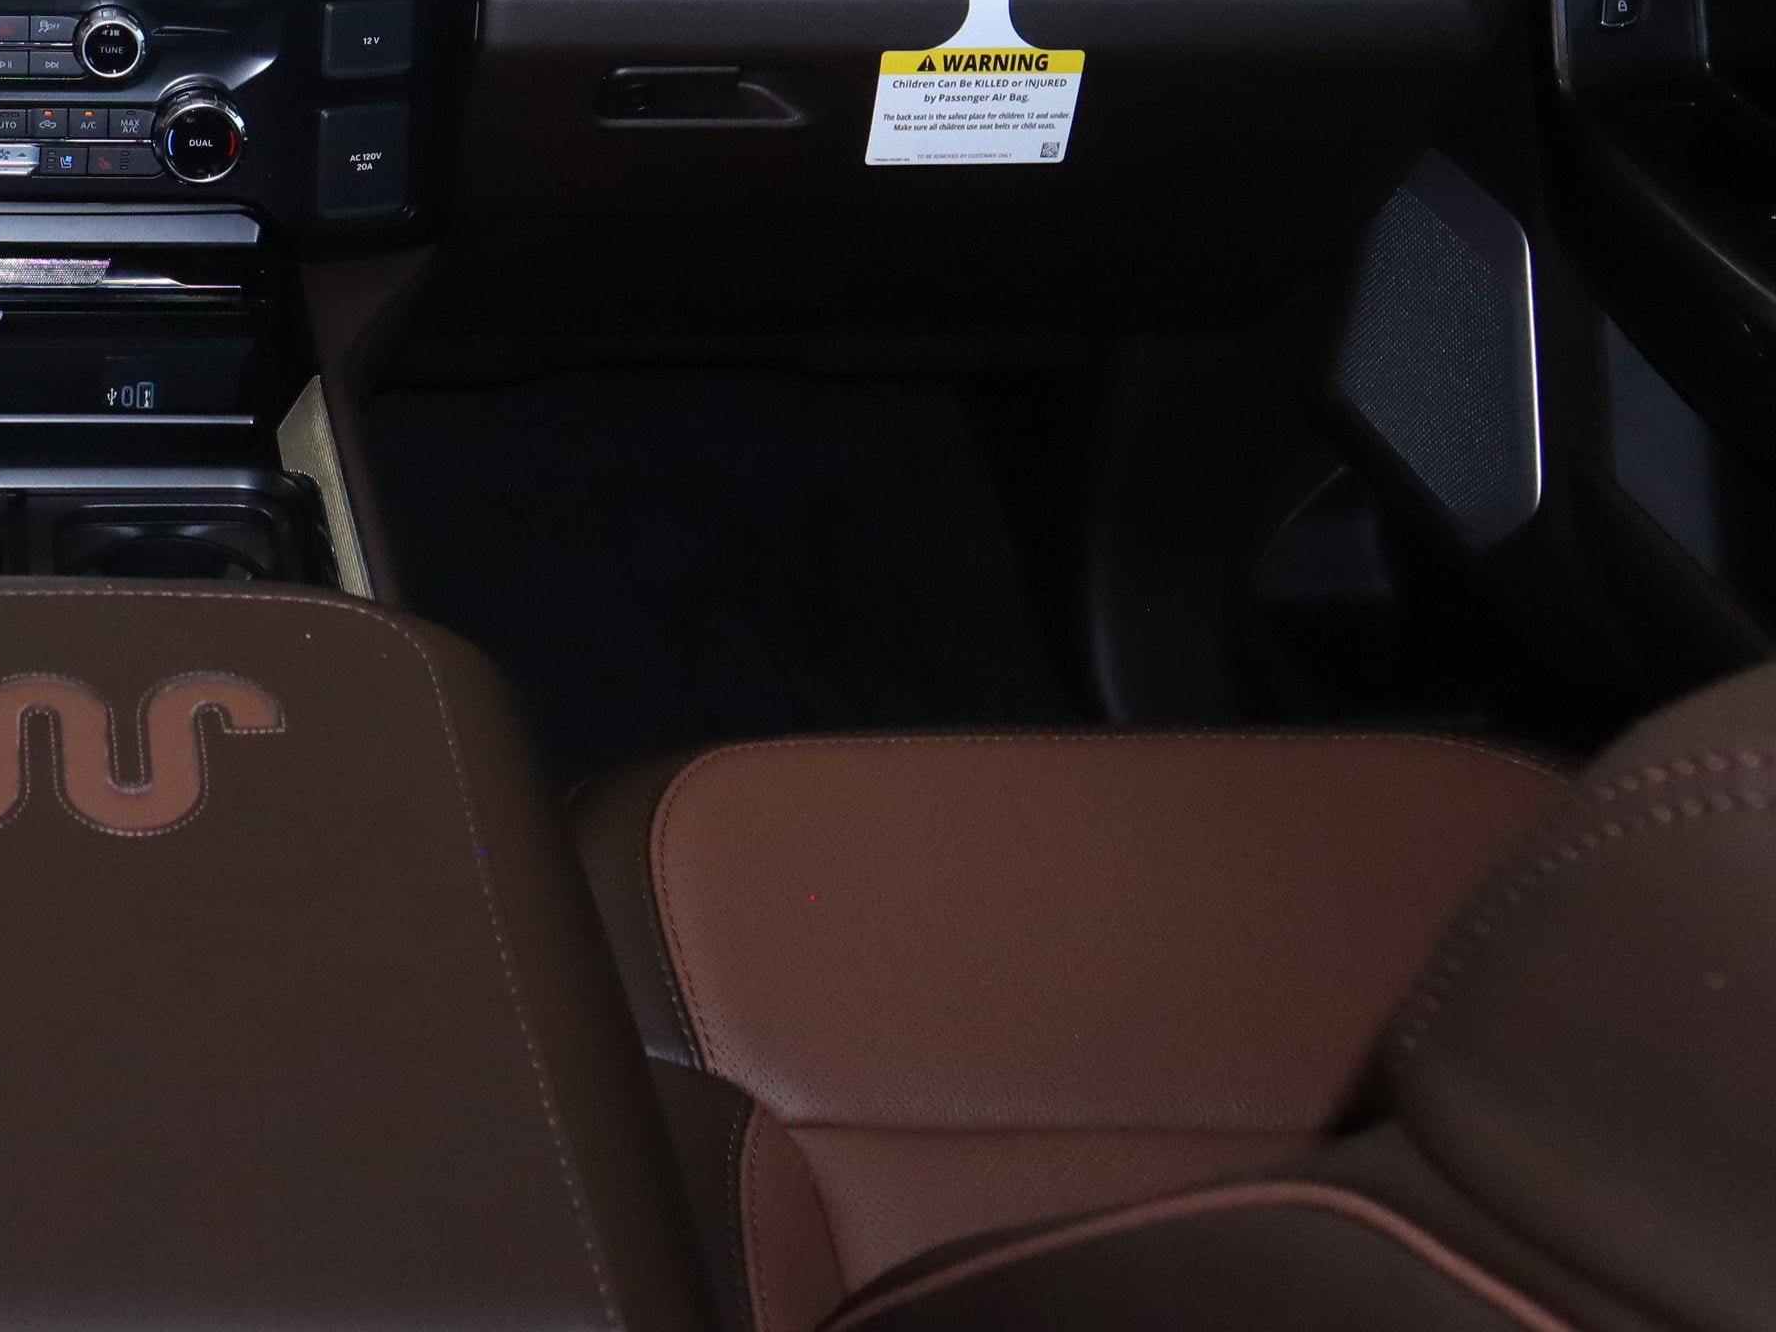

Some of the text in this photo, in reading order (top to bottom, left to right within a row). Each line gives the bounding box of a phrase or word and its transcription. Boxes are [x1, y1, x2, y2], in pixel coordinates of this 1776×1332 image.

[362, 36, 380, 45] 12 V
[99, 45, 124, 55] TUNE
[942, 53, 1050, 73] WARNING
[892, 79, 935, 89] Children
[937, 79, 957, 88] Can
[959, 79, 973, 88] Be
[974, 79, 1009, 88] KILLED
[1024, 78, 1068, 89] INJURED
[924, 93, 1030, 104] by Passenger Air Bag.
[883, 113, 895, 121] The
[896, 113, 912, 121] back
[913, 113, 927, 121] seat
[928, 113, 934, 121] is
[935, 113, 947, 121] the
[948, 112, 968, 121] safest
[968, 112, 986, 121] place
[987, 112, 998, 120] for
[998, 112, 1025, 120] children
[1049, 111, 1071, 119] under.
[79, 120, 97, 130] A/C
[120, 119, 140, 127] MAX
[928, 123, 937, 131] all
[938, 123, 965, 131] children
[994, 122, 1011, 130] belts
[122, 126, 139, 134] A/C
[188, 139, 214, 148] DUAL
[349, 151, 383, 162] AC 120V
[356, 162, 373, 172] 20A
